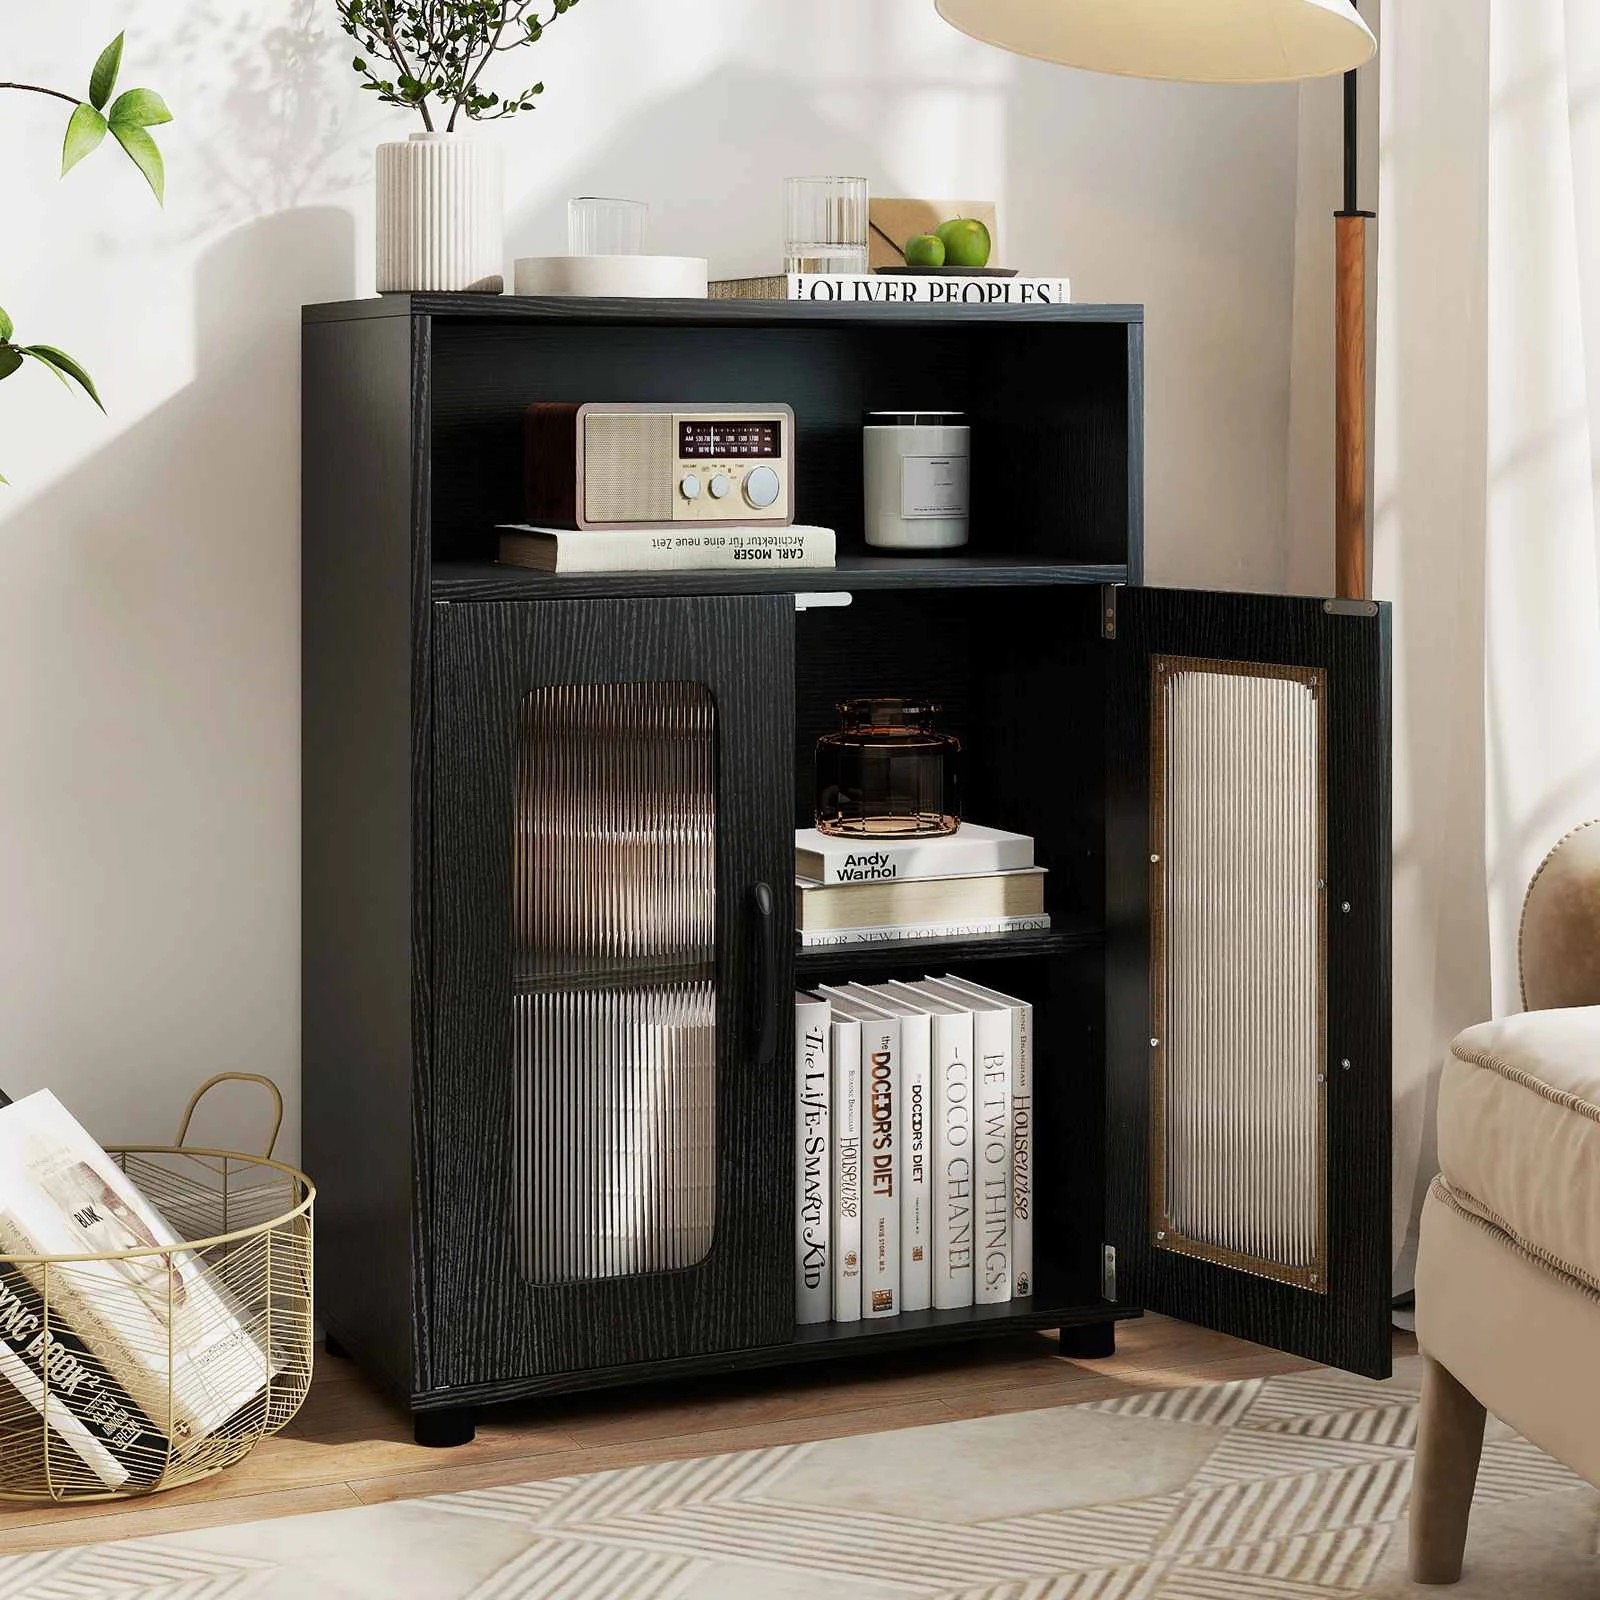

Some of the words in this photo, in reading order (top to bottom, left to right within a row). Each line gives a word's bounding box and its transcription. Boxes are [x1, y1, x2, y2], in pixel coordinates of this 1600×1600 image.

[652, 537, 672, 550] Zeit
[675, 538, 701, 547] neue
[704, 537, 726, 549] eine
[728, 537, 744, 548] für
[746, 536, 805, 548] Architektur
[733, 549, 772, 560] MOSER
[778, 548, 804, 559] CARL
[844, 852, 890, 868] Andy
[836, 864, 897, 881] Warhol
[881, 1035, 889, 1050] the
[983, 1054, 1005, 1085] BE
[984, 1092, 1006, 1164] TWO
[1012, 1094, 1031, 1221] Housewise
[873, 1154, 893, 1198] DIET
[912, 1154, 923, 1184] DIET
[840, 1137, 859, 1218] Housewise
[947, 1157, 970, 1280] CHANEL
